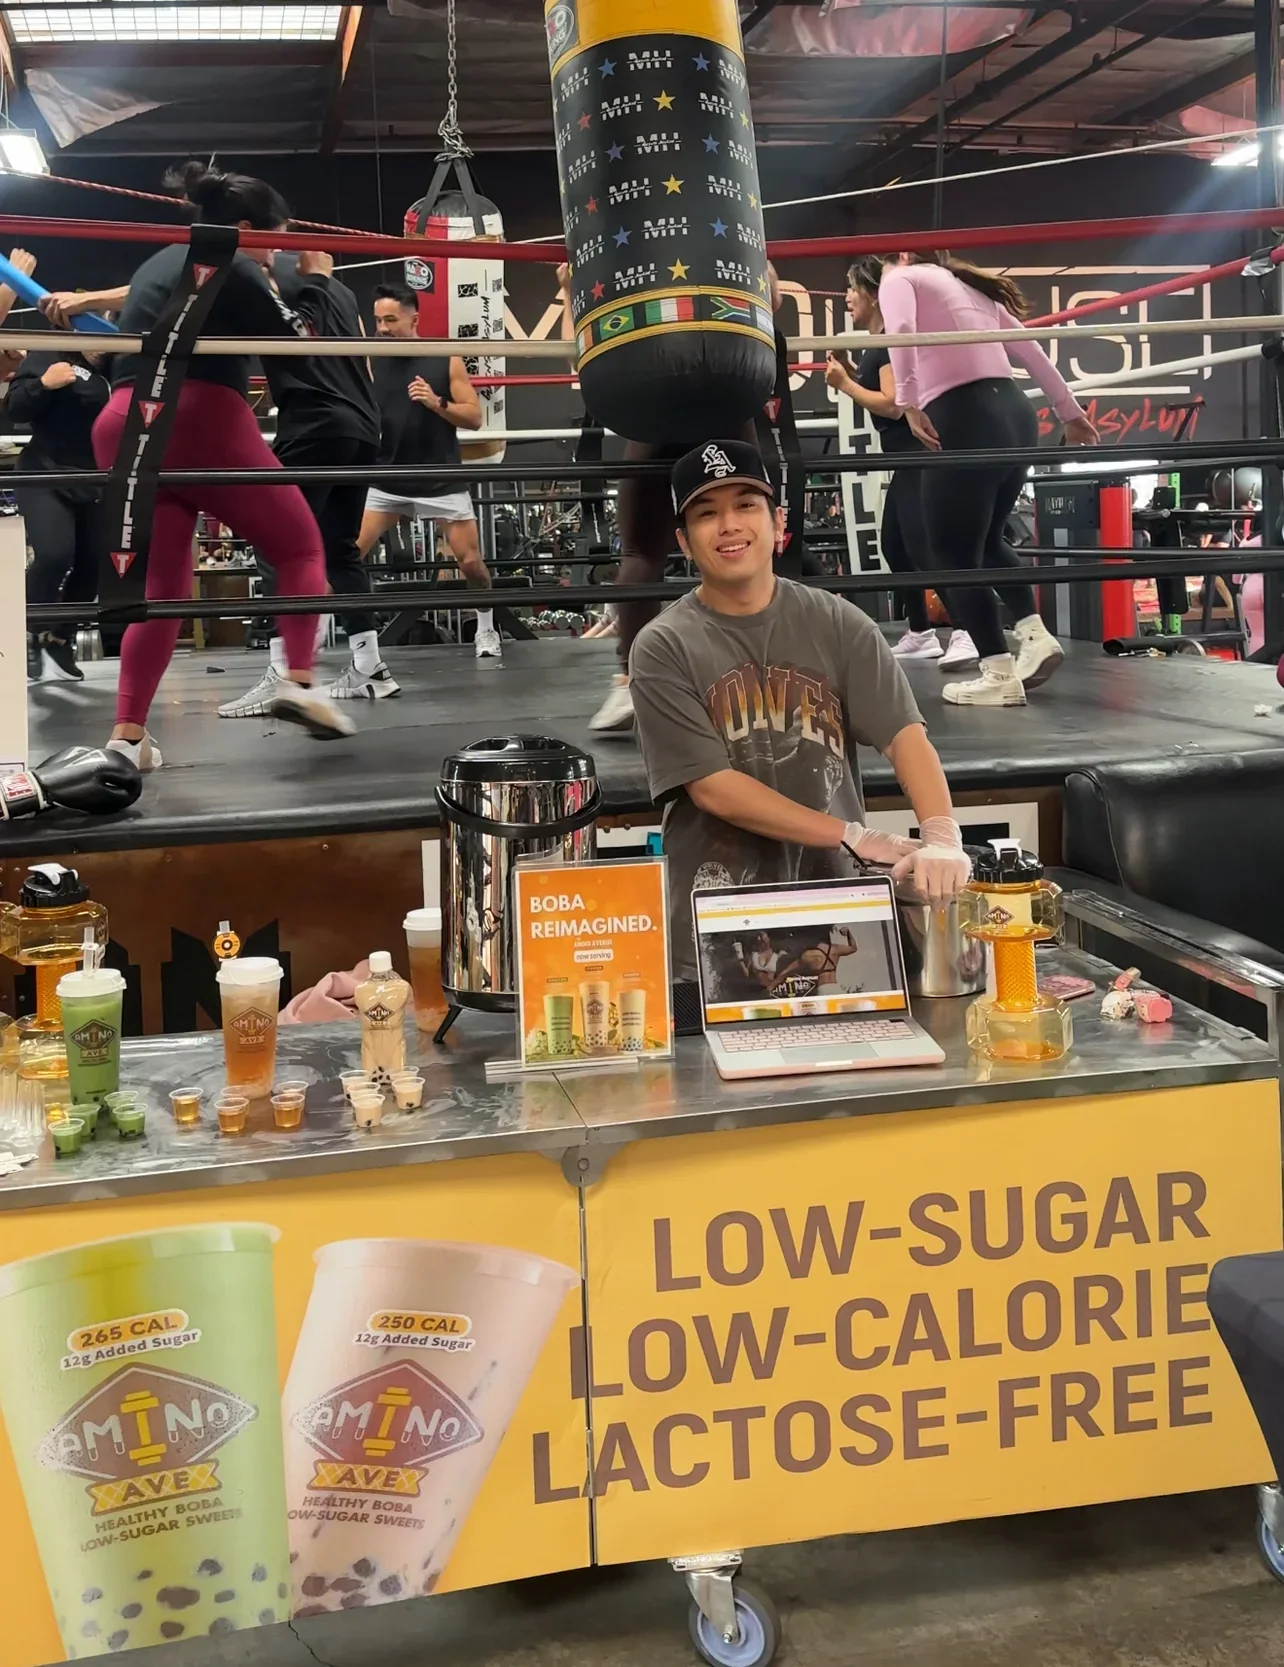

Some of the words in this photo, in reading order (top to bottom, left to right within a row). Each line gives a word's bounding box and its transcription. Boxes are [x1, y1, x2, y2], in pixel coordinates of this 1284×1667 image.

[121, 433, 150, 549] TITLE
[529, 894, 585, 914] BOBA
[530, 915, 658, 939] REIMAGINED.
[653, 1171, 1211, 1293] LOW-SUGAR
[81, 1326, 122, 1348] 265
[130, 1316, 178, 1336] CAL
[378, 1315, 415, 1330] 250
[420, 1318, 460, 1333] CAL
[568, 1263, 1212, 1401] LOW-CALORIE
[64, 1356, 92, 1369] 12g
[95, 1339, 147, 1360] Added
[152, 1331, 198, 1350] Sugar
[355, 1333, 379, 1345] 12g
[382, 1333, 428, 1346] Added
[431, 1336, 472, 1350] Sugar
[532, 1356, 1214, 1505] LACTOSE-FREE
[122, 1470, 191, 1502] AVE
[336, 1467, 400, 1488] AVE
[94, 1507, 169, 1534] HEALTHY
[175, 1497, 224, 1515] BOBA
[287, 1509, 370, 1523] OW-SUGAR
[302, 1496, 368, 1509] HEALTHY
[372, 1500, 413, 1514] BOBA
